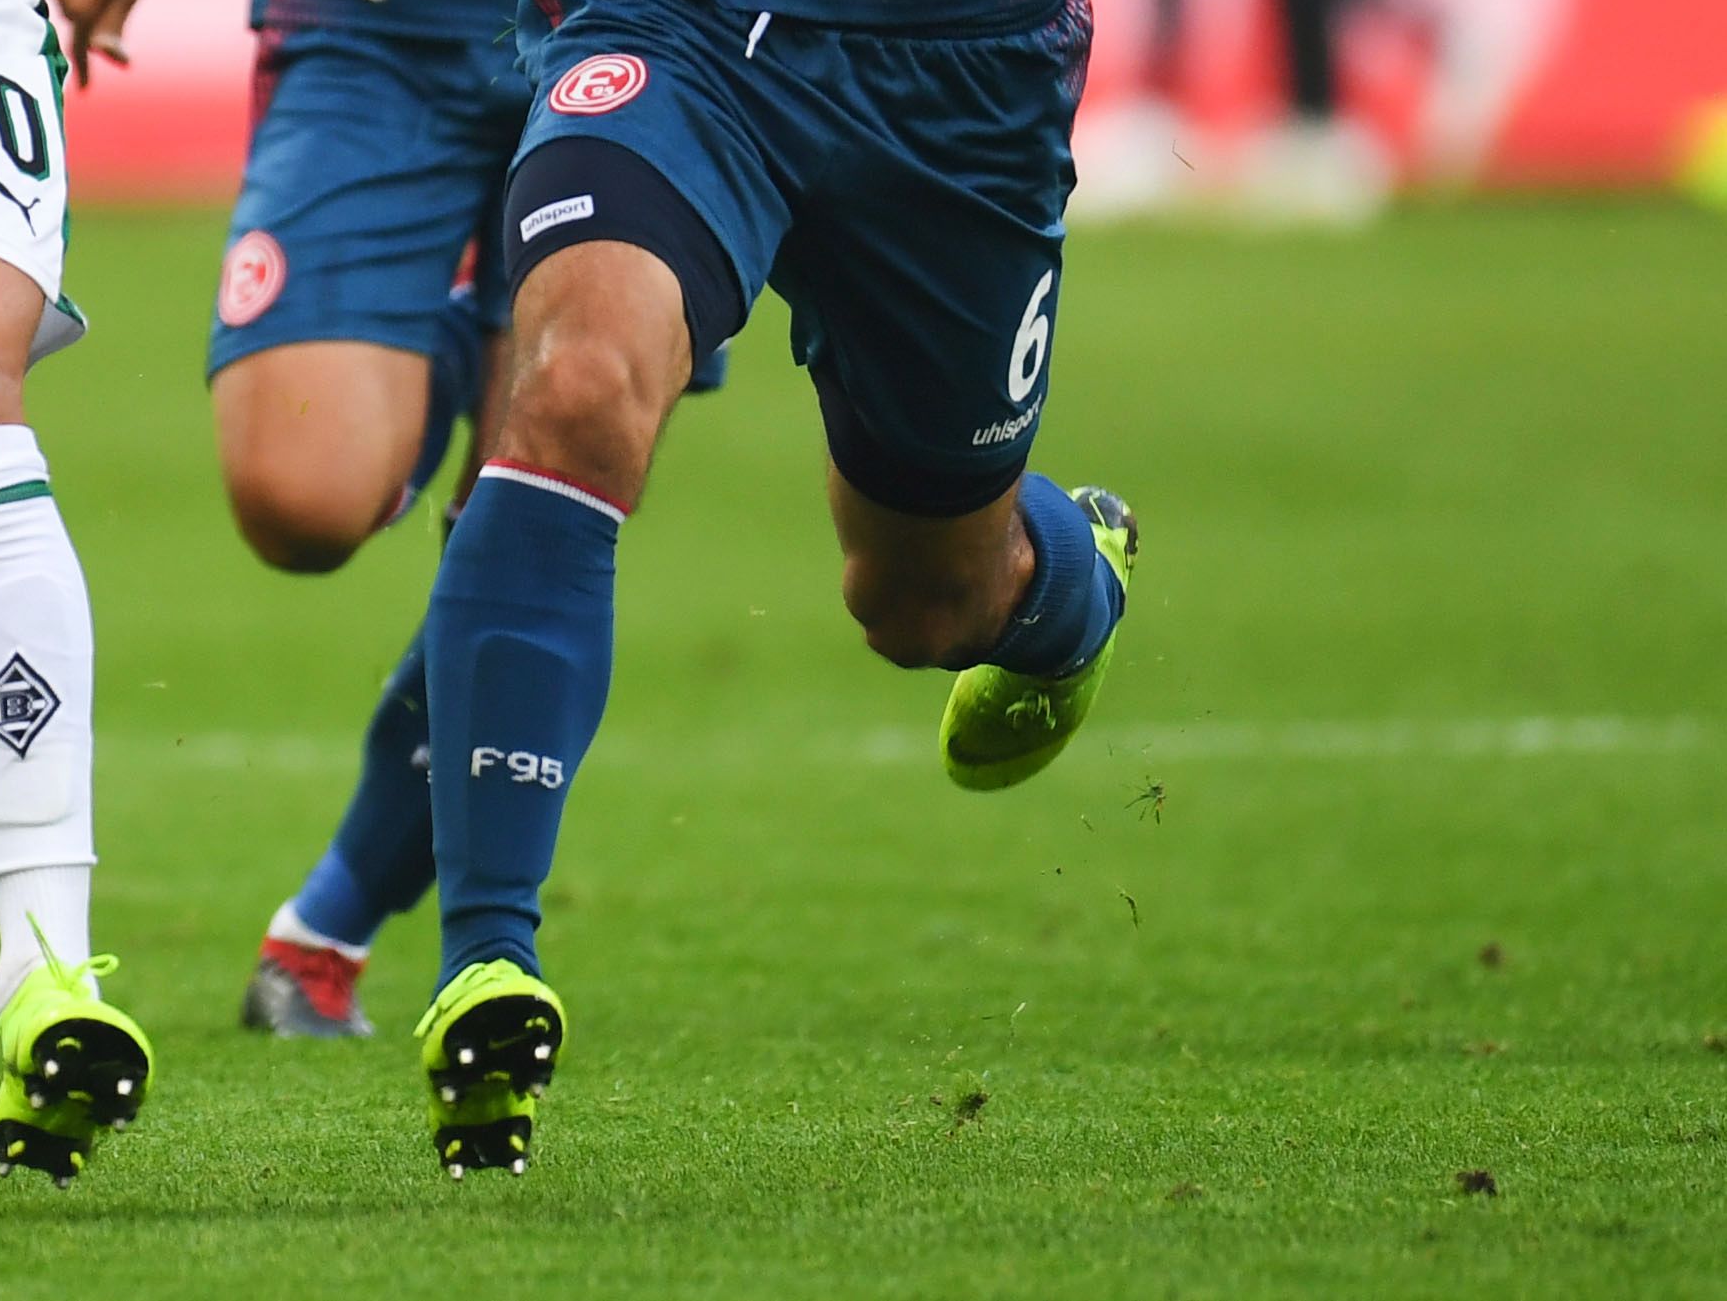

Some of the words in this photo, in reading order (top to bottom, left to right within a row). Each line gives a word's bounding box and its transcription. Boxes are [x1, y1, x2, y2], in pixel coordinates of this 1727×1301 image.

[524, 201, 587, 233] uhlsport
[1008, 269, 1053, 403] 6
[470, 746, 565, 790] F95
